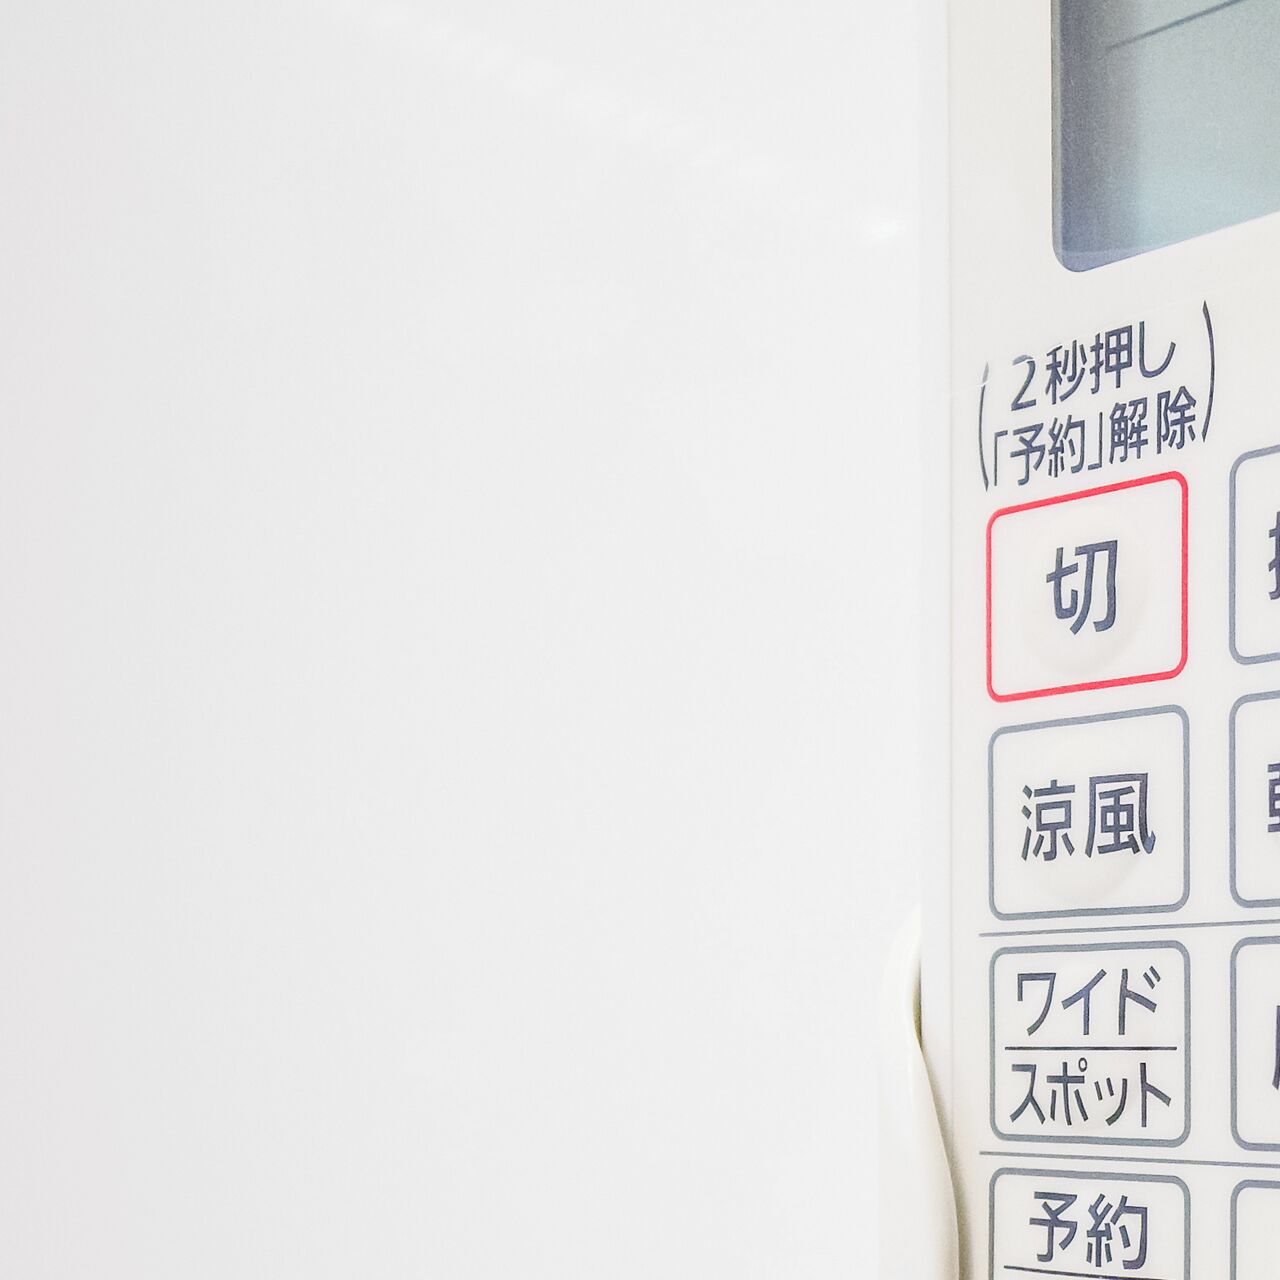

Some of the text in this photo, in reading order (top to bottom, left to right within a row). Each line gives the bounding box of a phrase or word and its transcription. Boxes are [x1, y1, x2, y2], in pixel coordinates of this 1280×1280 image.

[1045, 539, 1119, 636] 切
[1020, 772, 1156, 862] 涼風
[1016, 965, 1162, 1037] ワイド
[1008, 1057, 1172, 1128] スポット
[1028, 1190, 1149, 1271] 予約
